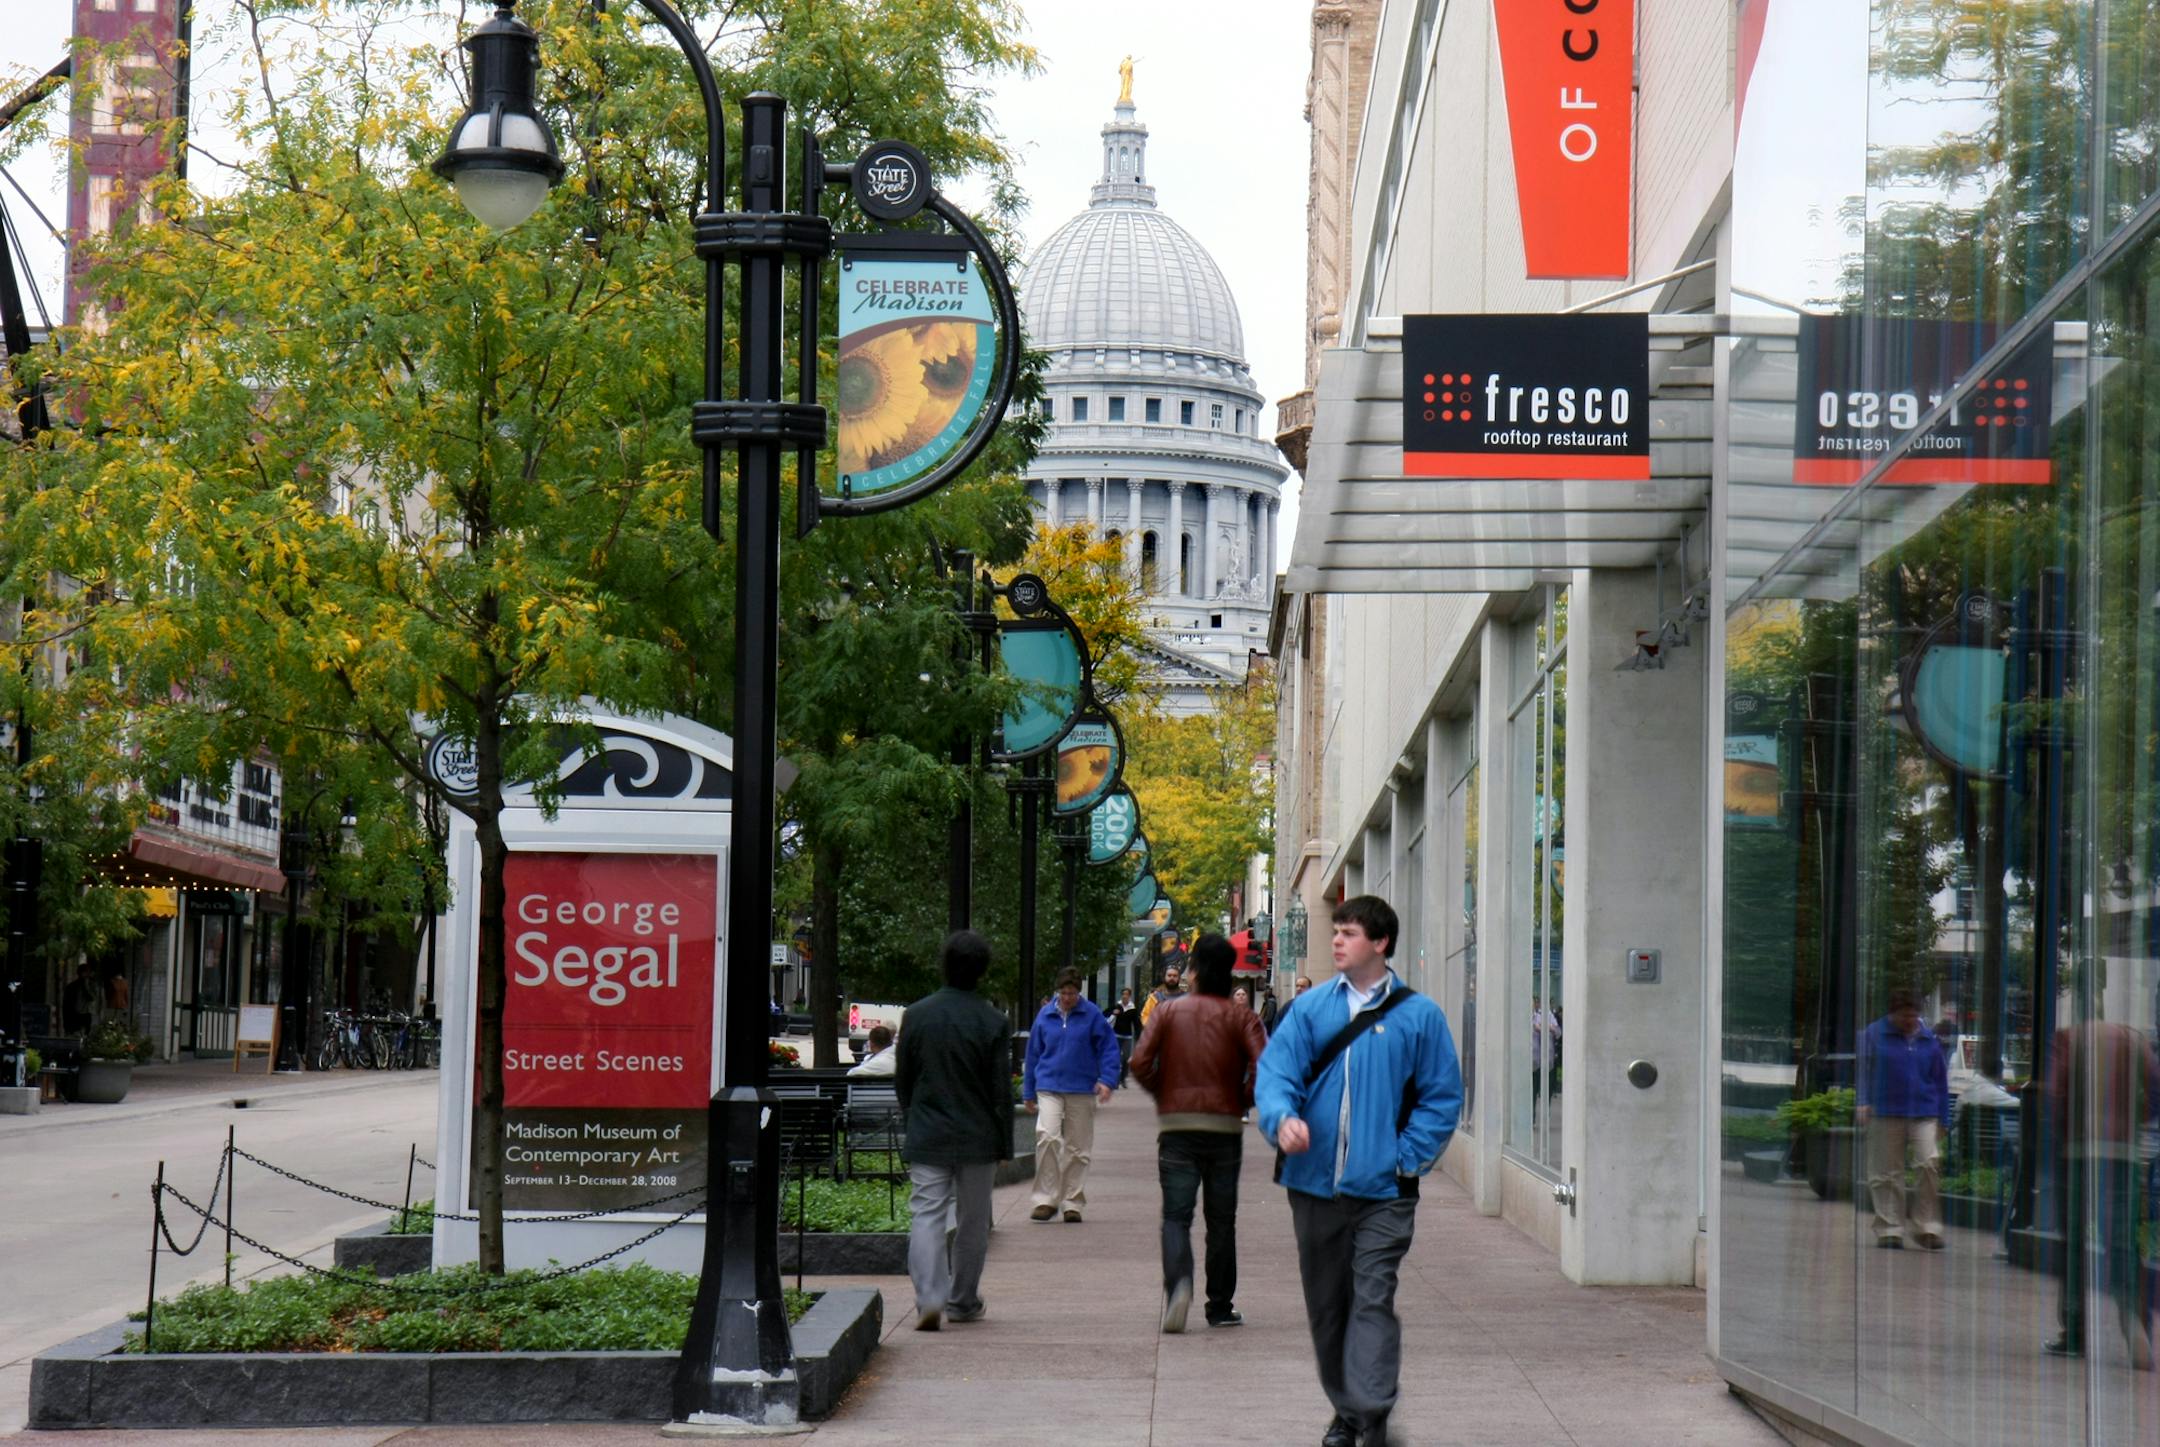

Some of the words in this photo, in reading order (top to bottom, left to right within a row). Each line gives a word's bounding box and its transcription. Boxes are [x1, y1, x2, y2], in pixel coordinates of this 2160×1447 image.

[1559, 87, 1598, 163] OF
[867, 164, 908, 184] STATE
[867, 181, 906, 197] Street
[855, 279, 969, 295] CELEBRATE
[852, 290, 963, 314] Madison
[1485, 373, 1630, 425] fresco
[861, 416, 968, 488] CELEBRATE
[969, 351, 991, 401] FALL
[1484, 430, 1541, 448] rooftop
[1547, 431, 1628, 447] restaurant
[441, 750, 478, 765] STAT
[441, 763, 478, 778] Stree
[1105, 794, 1129, 851] 200
[518, 893, 681, 935] George
[514, 931, 679, 1006] Segal
[505, 1049, 585, 1071] Street
[596, 1050, 683, 1072] Scenes
[505, 1122, 578, 1140] Madison
[583, 1123, 657, 1140] Museum
[662, 1124, 682, 1140] of
[505, 1146, 641, 1167] Contemporary
[647, 1147, 680, 1164] Art
[504, 1174, 554, 1186] SEPTEMBER
[631, 1175, 648, 1187] 28,
[650, 1176, 677, 1187] 2008
